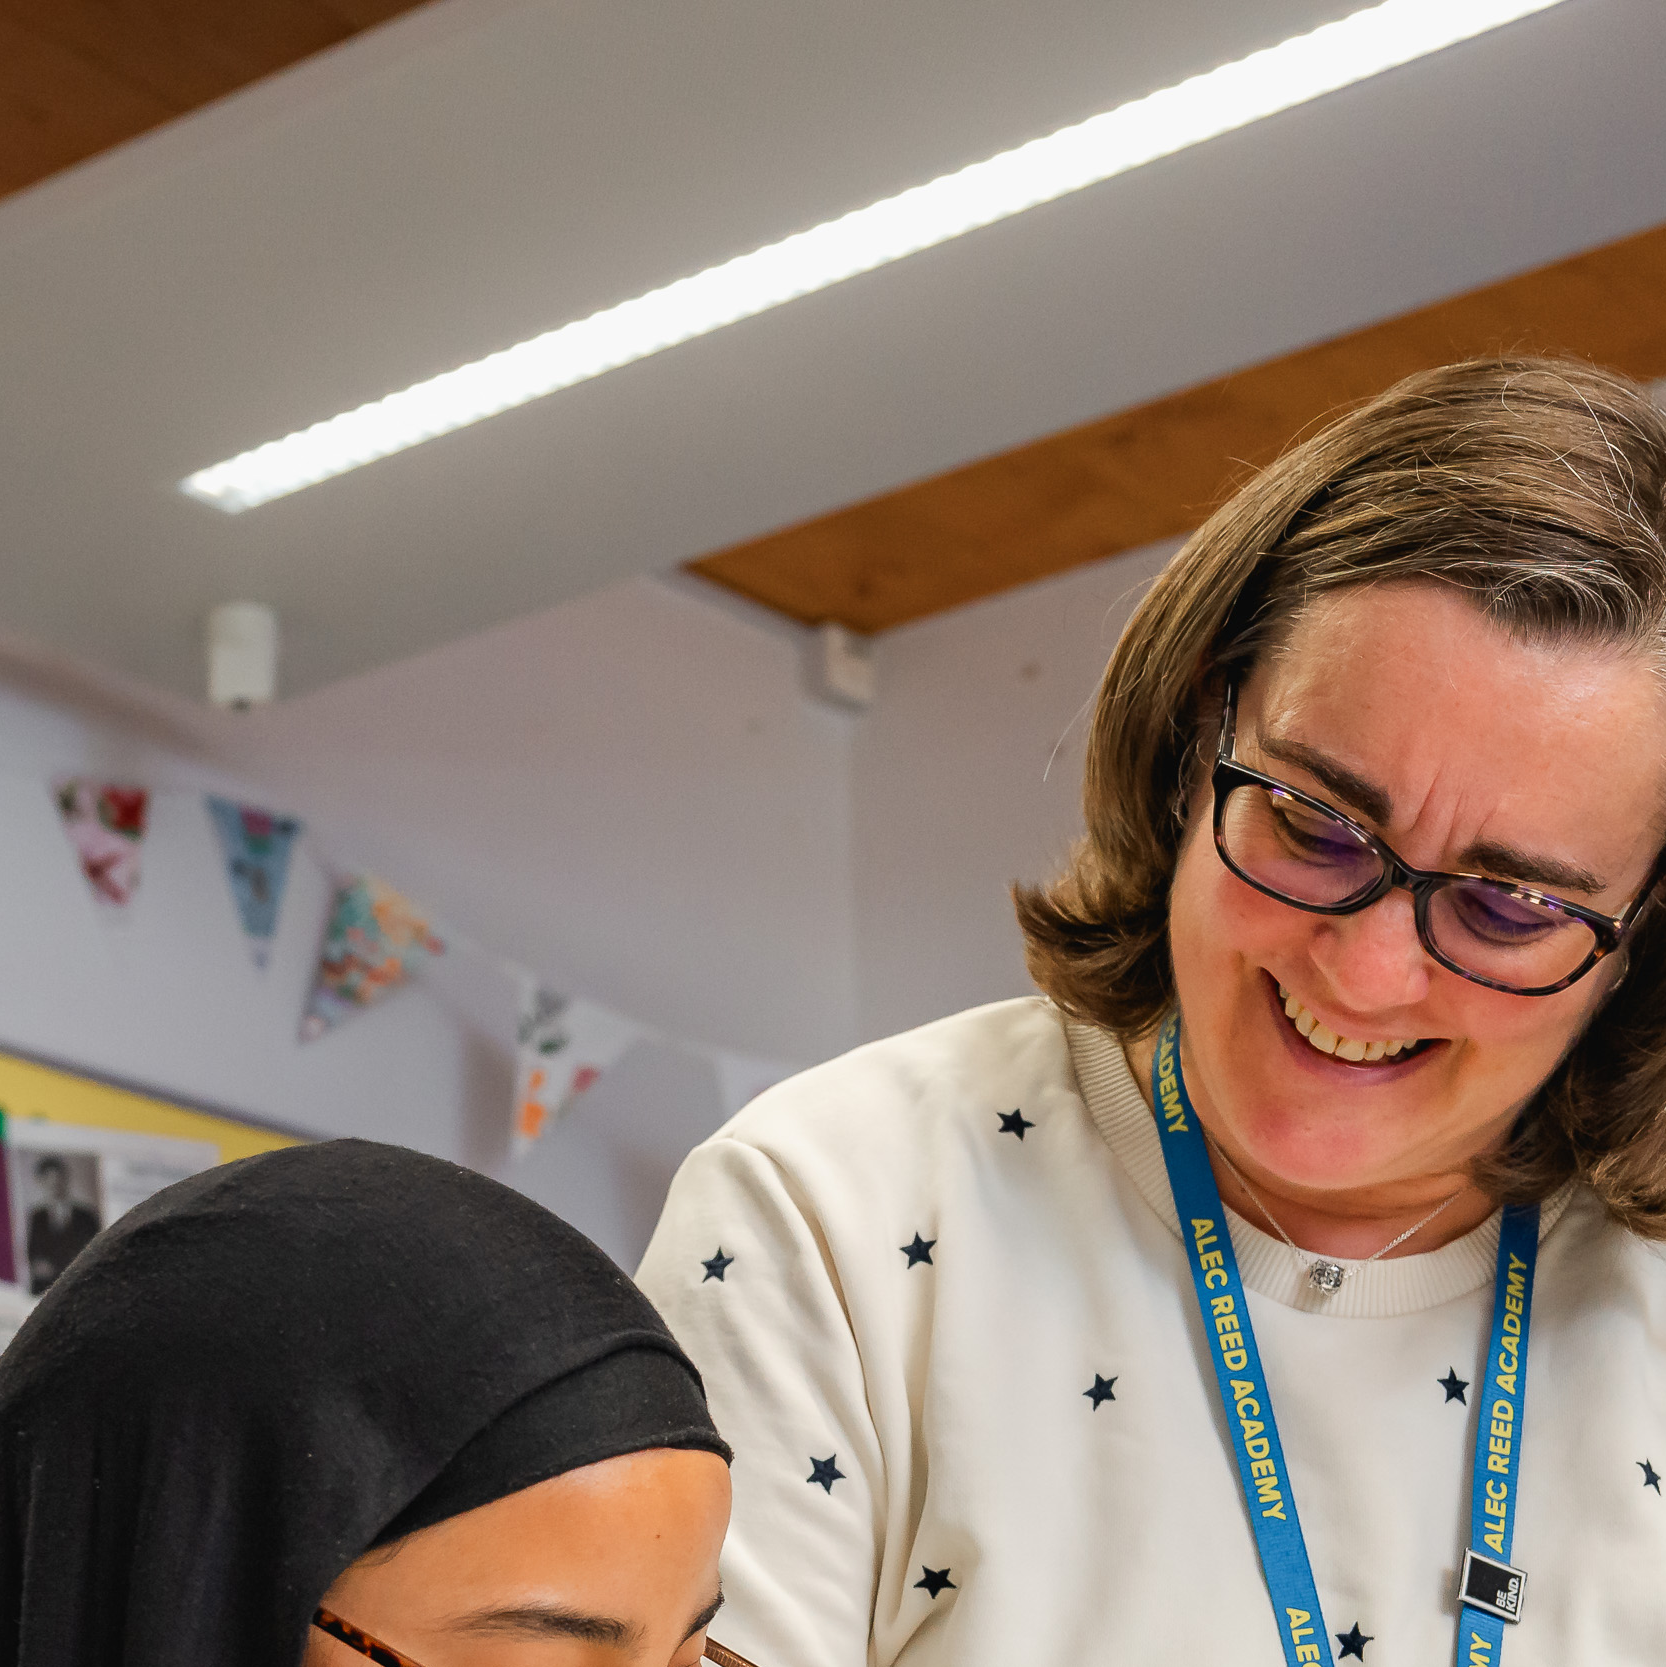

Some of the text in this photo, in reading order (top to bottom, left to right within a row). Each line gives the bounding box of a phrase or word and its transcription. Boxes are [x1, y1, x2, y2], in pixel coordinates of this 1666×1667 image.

[1191, 1218, 1287, 1521] ALEC REED ACADEMY
[1484, 1253, 1529, 1554] ALEC REED ACADEMY
[1495, 1589, 1507, 1608] BE
